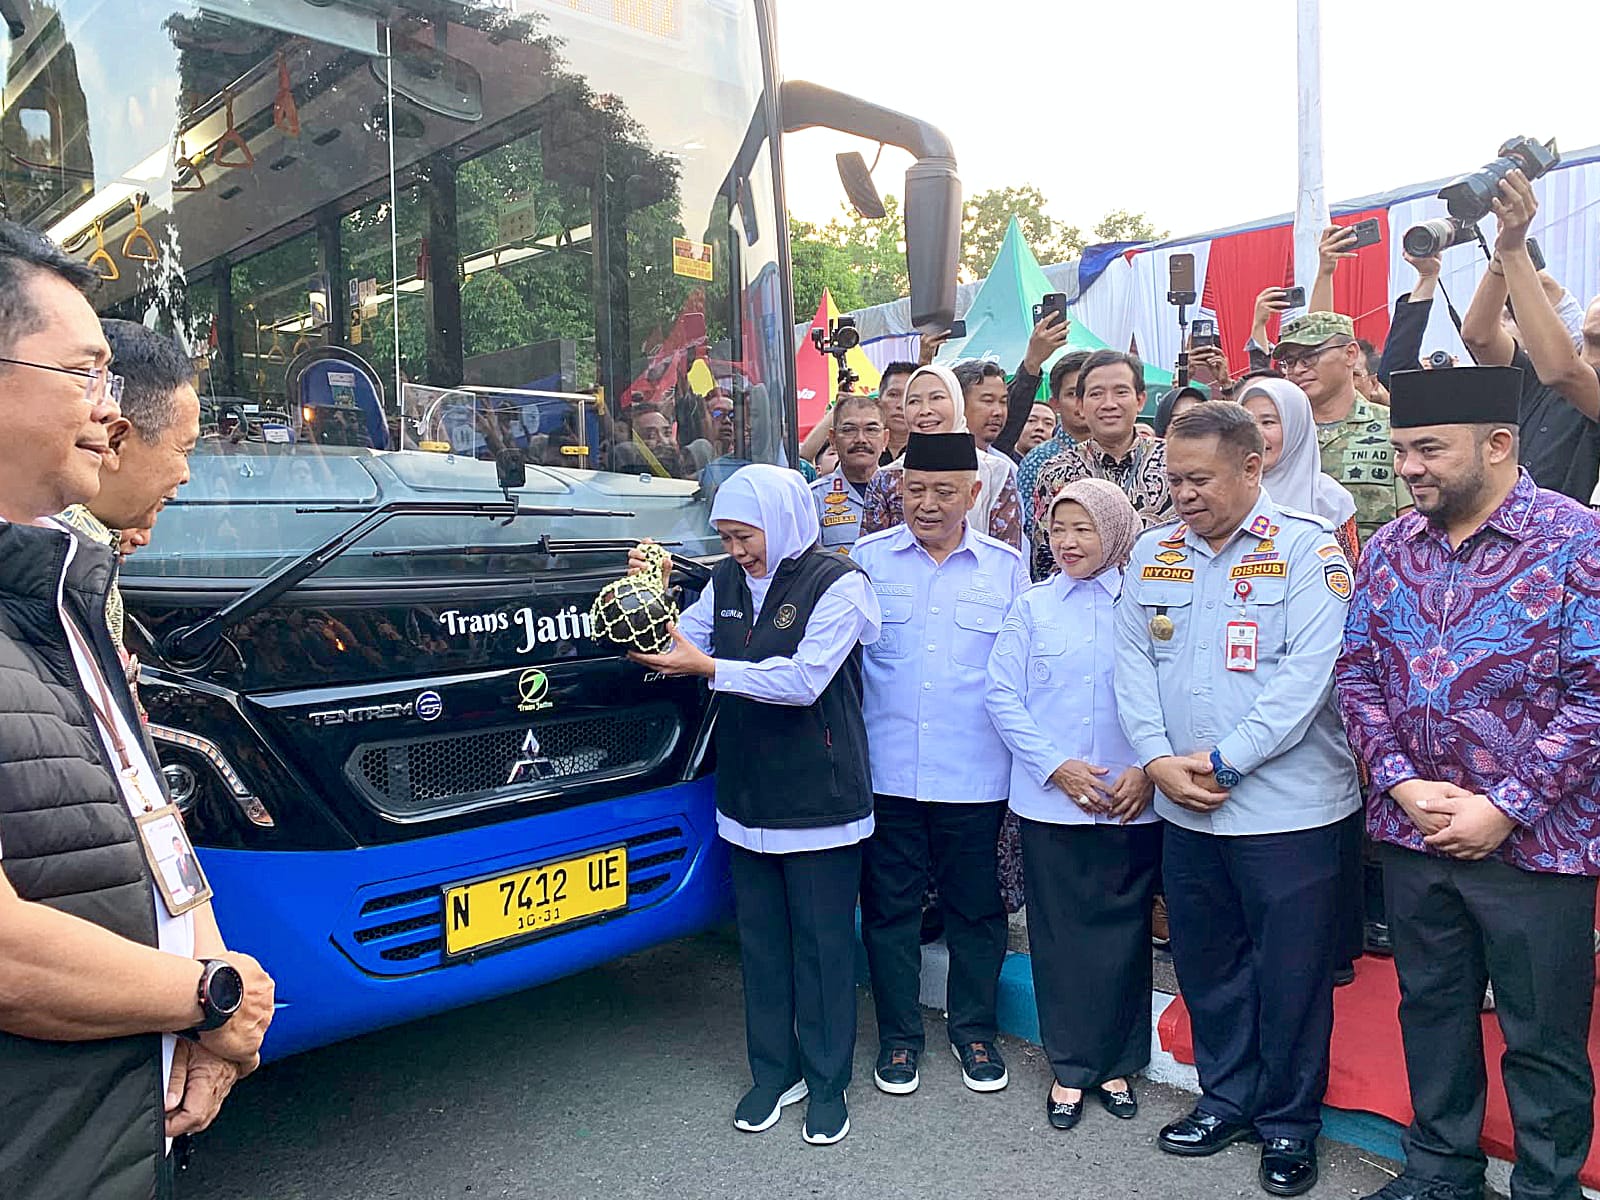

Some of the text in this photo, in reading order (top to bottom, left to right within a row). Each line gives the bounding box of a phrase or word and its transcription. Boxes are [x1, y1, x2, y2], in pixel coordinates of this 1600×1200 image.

[1351, 450, 1388, 460] TNI AD
[1144, 567, 1192, 579] NYONO
[1233, 564, 1281, 576] DISHUB
[439, 610, 509, 636] Trans
[309, 702, 413, 726] TENTREM
[453, 855, 620, 930] N 7412 UE
